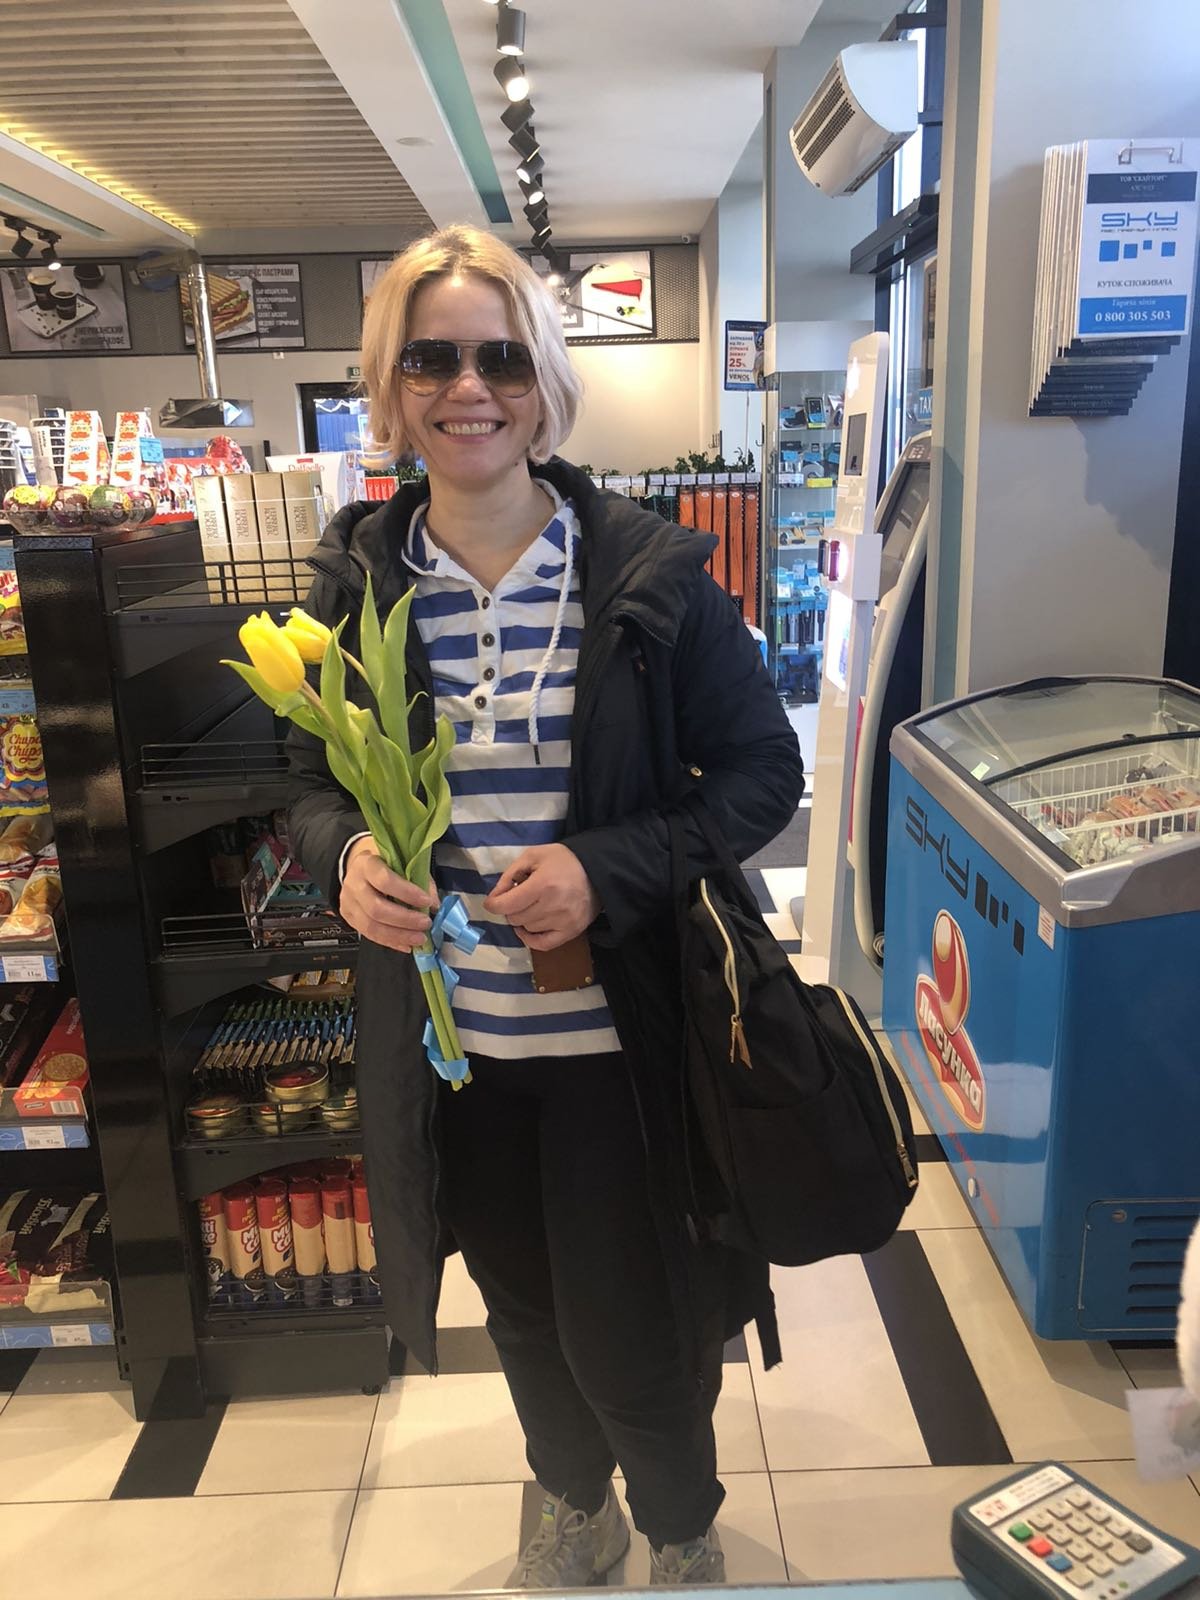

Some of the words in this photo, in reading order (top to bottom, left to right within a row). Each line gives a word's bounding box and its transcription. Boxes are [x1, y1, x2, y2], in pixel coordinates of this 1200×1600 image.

[1101, 211, 1178, 228] SKY
[1097, 280, 1123, 288] КУТОК
[1095, 312, 1102, 322] 0
[1104, 312, 1125, 322] 800
[1128, 311, 1148, 321] 305
[1150, 310, 1171, 321] 503
[920, 396, 932, 414] TAX
[906, 796, 970, 900] SKY
[920, 991, 982, 1114] Ласунка
